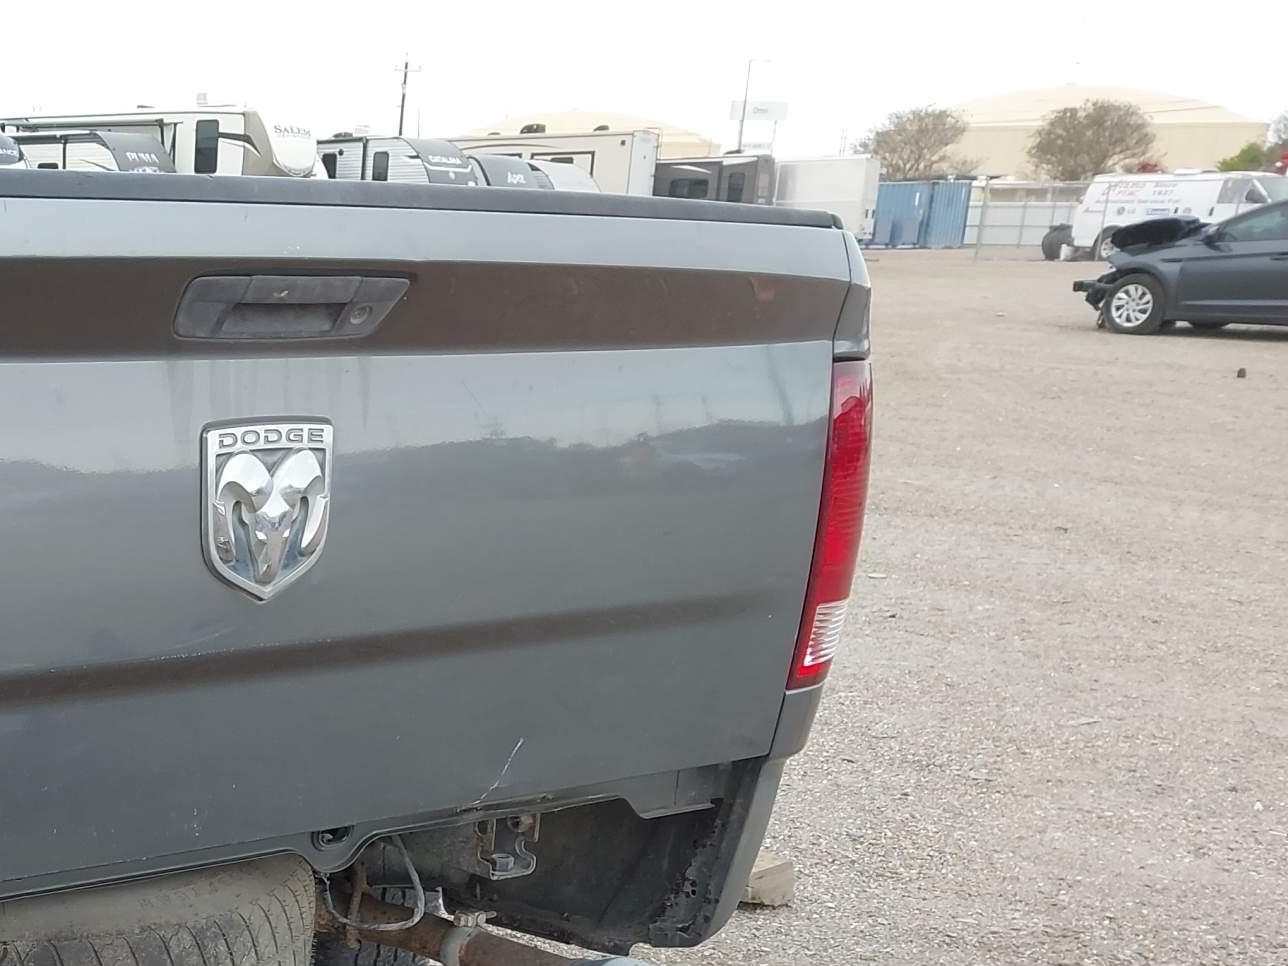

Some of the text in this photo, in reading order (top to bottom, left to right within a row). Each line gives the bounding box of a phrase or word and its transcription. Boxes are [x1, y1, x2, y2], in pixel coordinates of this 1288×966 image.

[273, 125, 311, 137] SALEM
[126, 151, 160, 164] PUMA
[428, 155, 463, 165] CATALINA
[218, 427, 325, 449] DODGE
